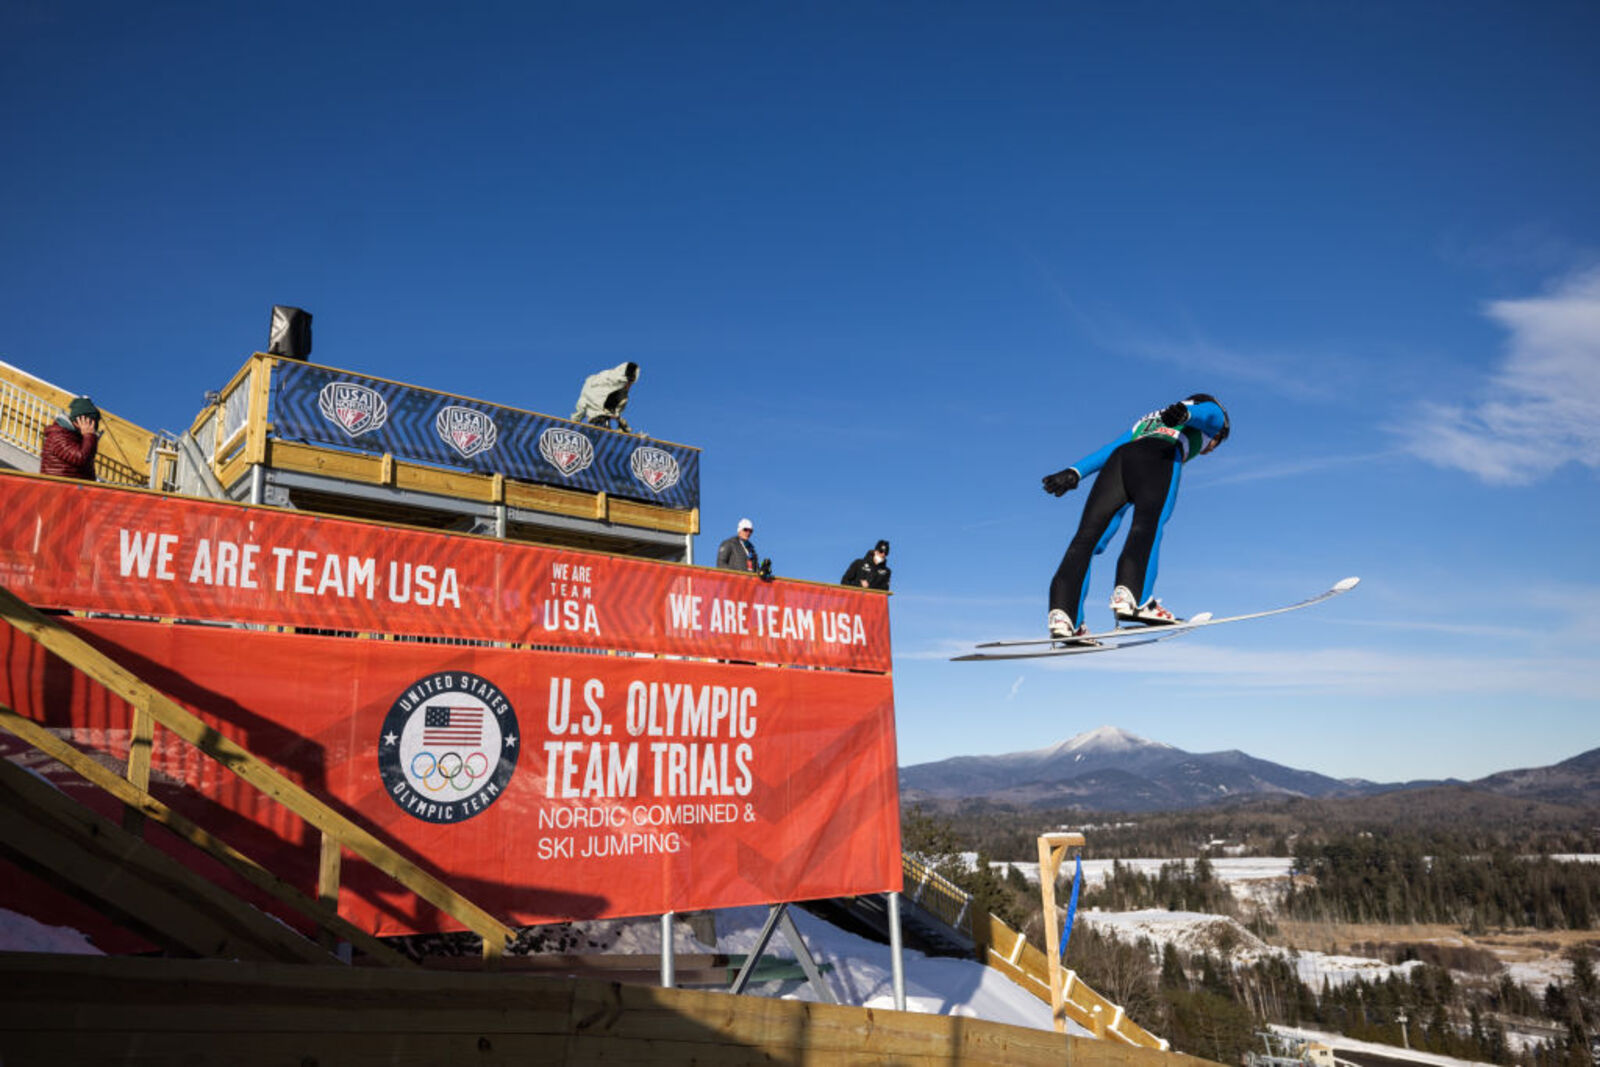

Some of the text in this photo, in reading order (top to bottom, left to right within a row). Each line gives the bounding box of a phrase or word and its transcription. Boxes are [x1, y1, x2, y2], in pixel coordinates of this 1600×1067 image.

[338, 388, 368, 405] USA
[453, 412, 480, 427] USA
[555, 433, 579, 446] USA
[644, 452, 665, 465] USA
[119, 528, 461, 608] WE ARE TEAM USA
[552, 562, 591, 583] WE ARE
[551, 582, 591, 599] TEAM
[543, 599, 601, 636] USA
[669, 593, 867, 646] WE ARE TEAM USA
[399, 675, 509, 714] UNITED STATES
[547, 677, 757, 739] U.S. OLYMPIC
[543, 741, 753, 799] TEAM TRIALS
[392, 781, 500, 820] OLYMPIC TEAM
[538, 803, 756, 830] NORDIC COMBINED &
[537, 832, 681, 860] SKI JUMPING
